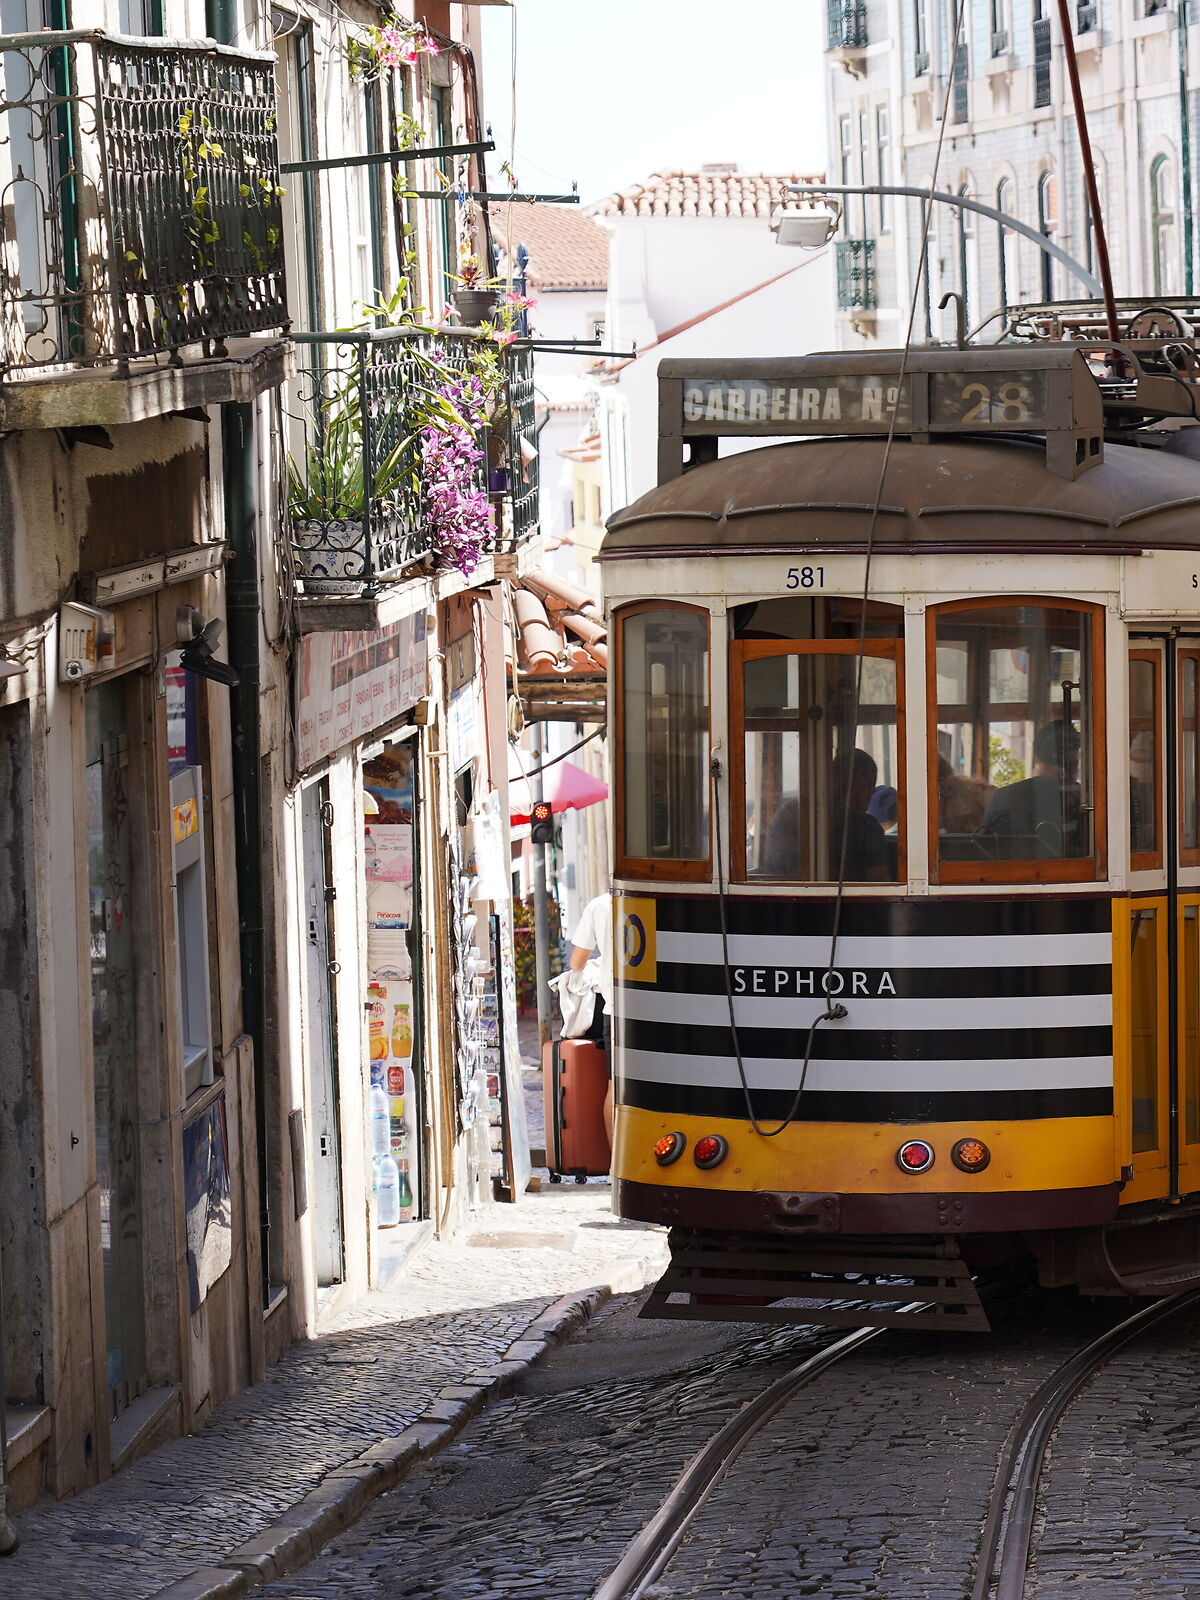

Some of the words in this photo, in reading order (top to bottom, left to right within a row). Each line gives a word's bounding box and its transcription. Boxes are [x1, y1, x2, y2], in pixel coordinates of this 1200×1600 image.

[685, 387, 842, 422] CARREIRA
[962, 382, 1029, 424] 28
[786, 566, 824, 589] 581
[734, 968, 897, 995] SEPHORA
